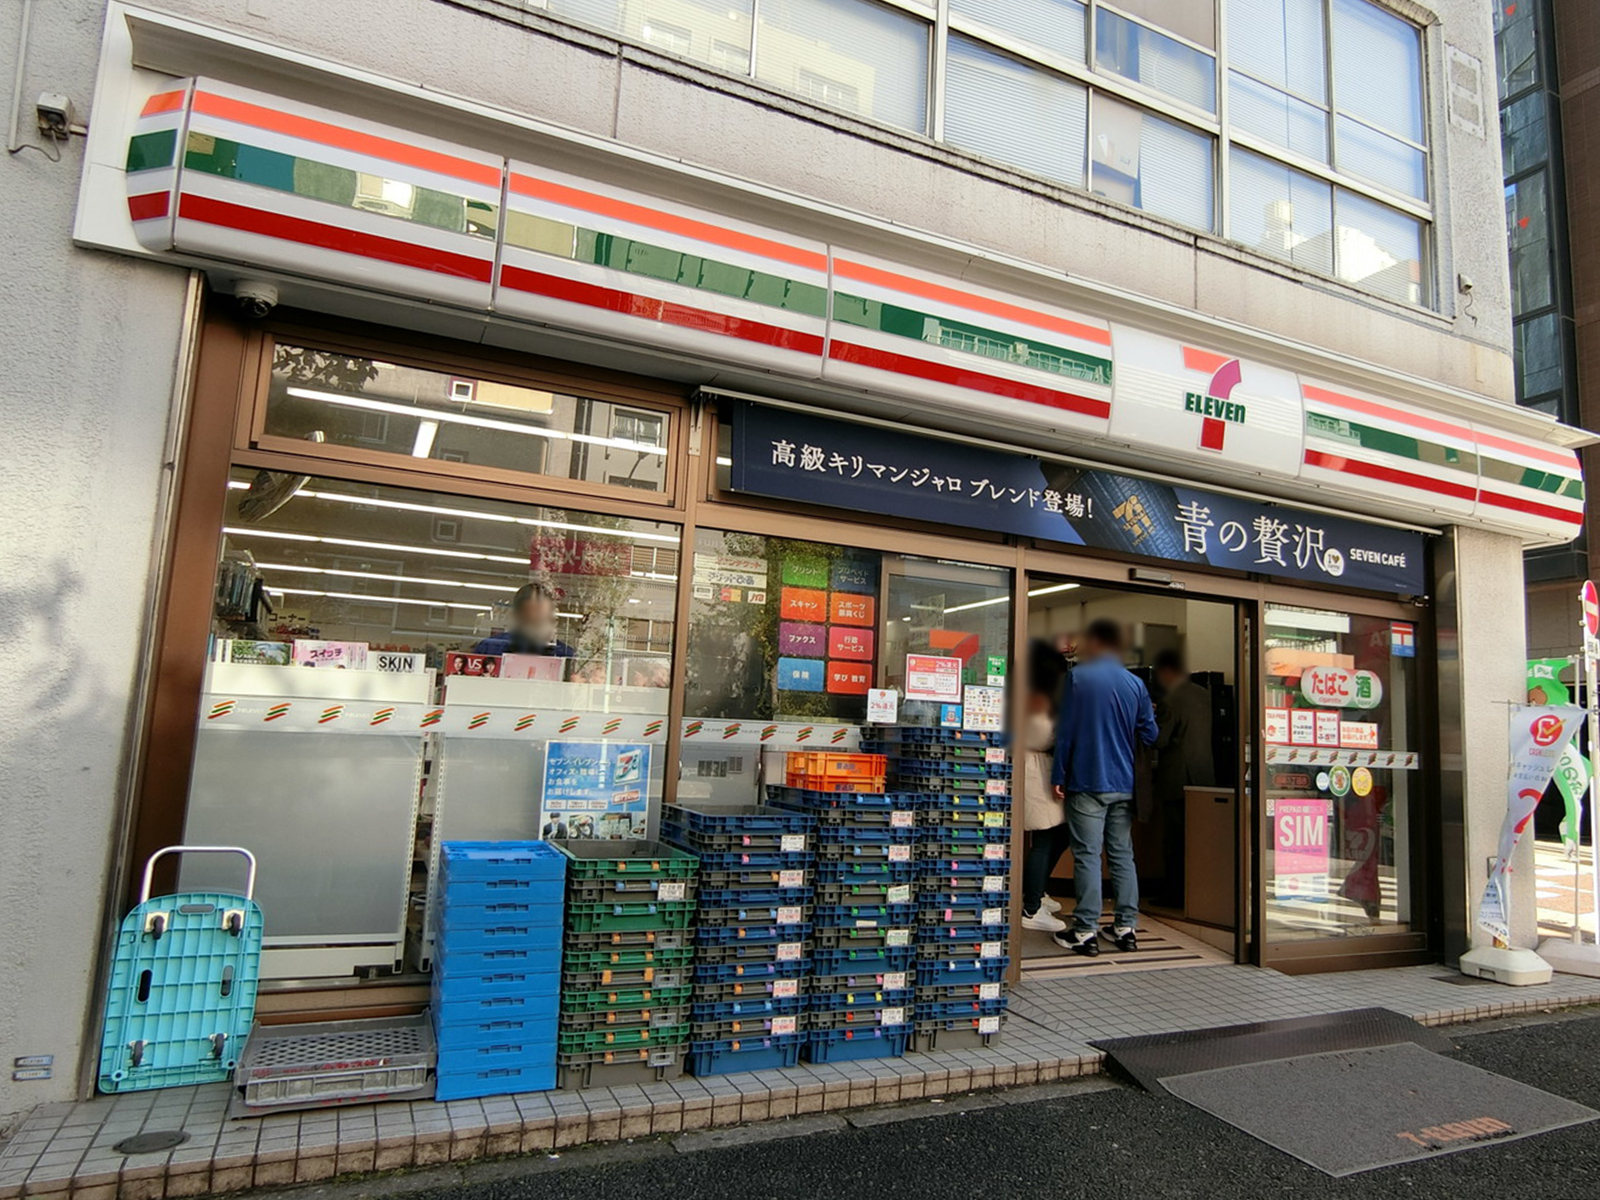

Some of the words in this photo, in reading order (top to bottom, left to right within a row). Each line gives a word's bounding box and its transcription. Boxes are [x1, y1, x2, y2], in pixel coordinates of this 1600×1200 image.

[1174, 501, 1328, 572] 青の贅沢
[1349, 548, 1381, 564] SEVEN
[1381, 553, 1407, 568] CAFÉ
[839, 575, 867, 585] サービス
[790, 599, 818, 610] スキャン
[838, 600, 867, 611] スポーツ
[269, 612, 306, 623] コーナー
[788, 634, 817, 645] ファクス
[843, 635, 859, 644] 行政
[837, 643, 866, 653] サービス
[379, 656, 414, 670] SKIN
[833, 673, 849, 683] 学び
[1311, 671, 1349, 696] たばこ
[1355, 675, 1372, 698] 酒
[1279, 815, 1324, 847] SIM
